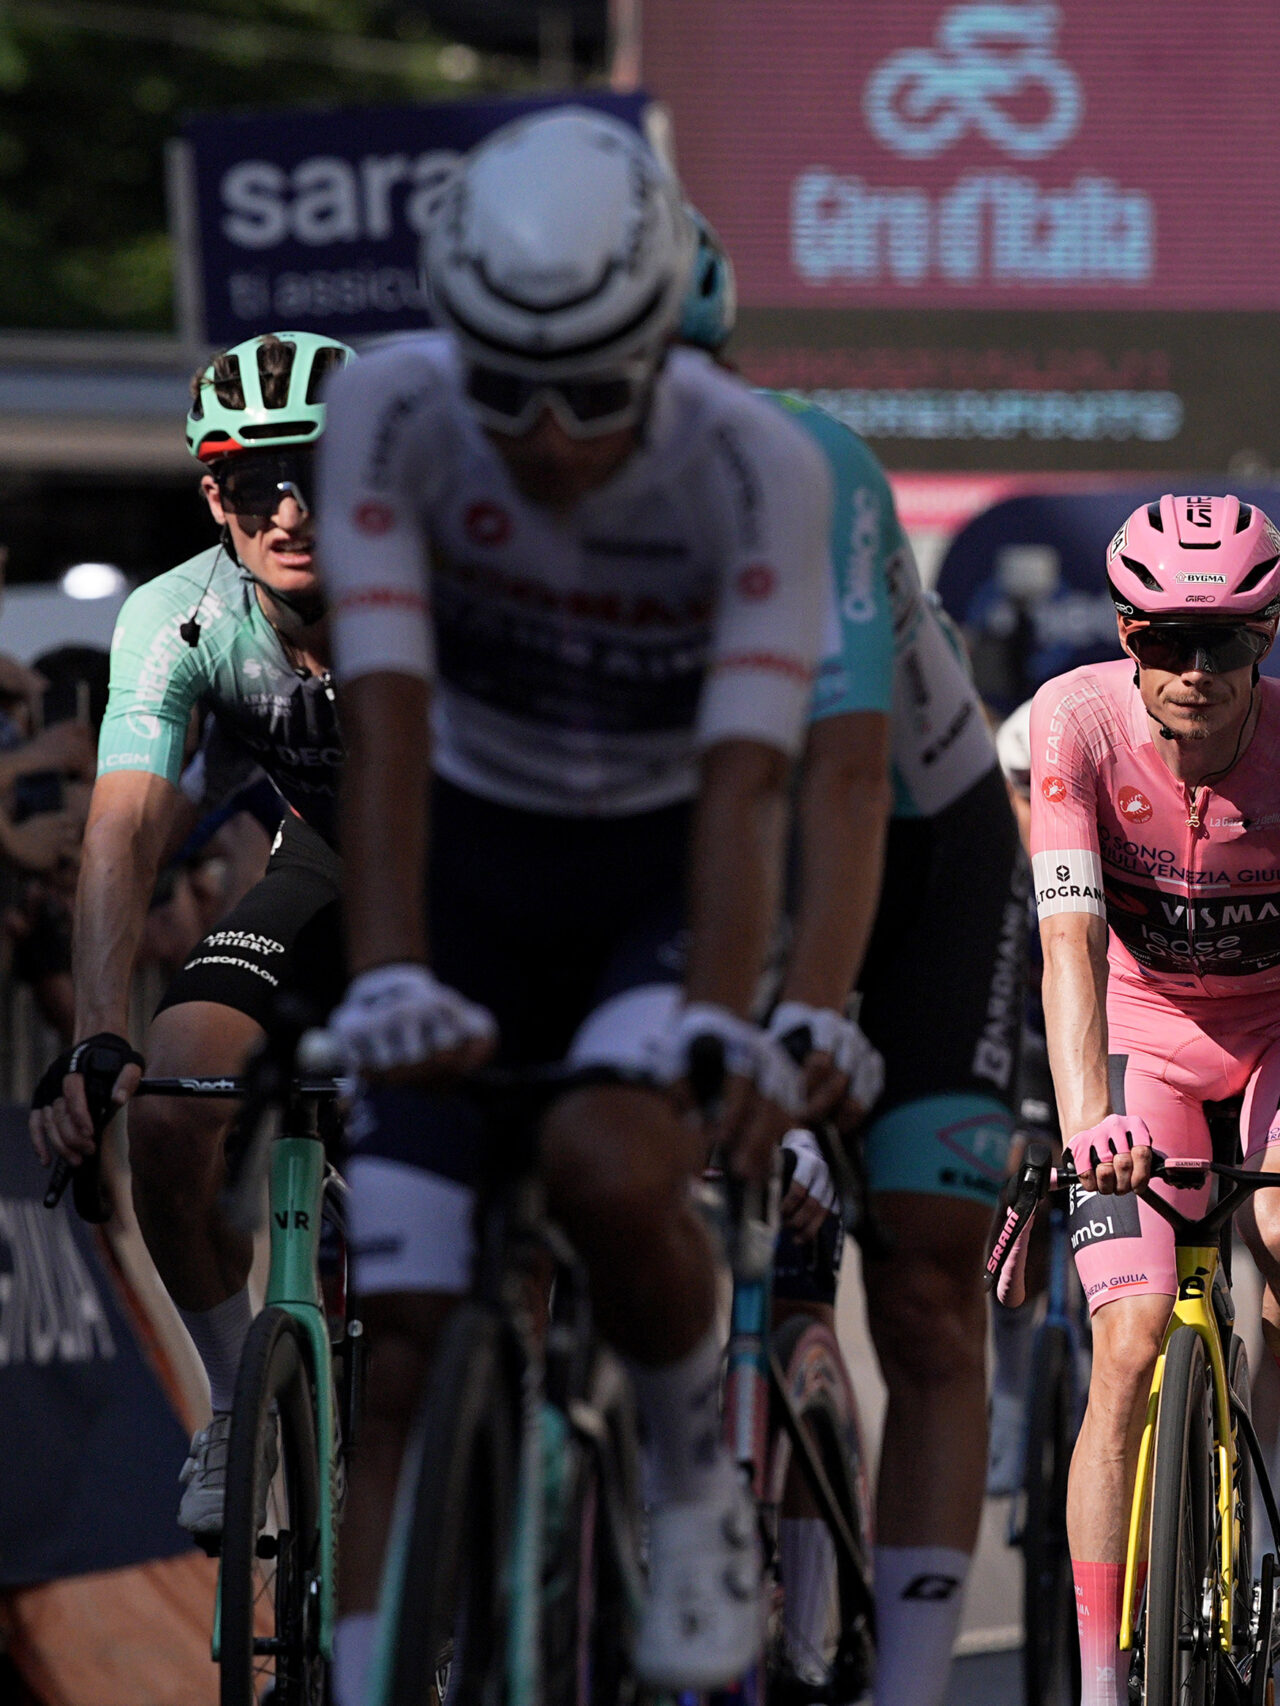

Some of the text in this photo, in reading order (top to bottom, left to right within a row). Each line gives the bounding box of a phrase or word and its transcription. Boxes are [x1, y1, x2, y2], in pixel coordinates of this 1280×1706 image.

[1186, 574, 1225, 583] BYGMA
[1185, 595, 1216, 603] GIRO
[1045, 684, 1102, 764] CASTELLI
[1100, 842, 1138, 869] RIULI
[1143, 861, 1233, 884] VENEZIA
[1109, 834, 1176, 864] SONO
[1161, 900, 1280, 931] VISMA
[203, 930, 285, 954] ARMAND
[208, 938, 274, 956] THIERY
[1141, 922, 1242, 952] lease
[202, 955, 279, 987] DECATHLON
[274, 1210, 311, 1231] VR
[985, 1205, 1020, 1274] SRAM
[1109, 1273, 1149, 1286] GIULIA
